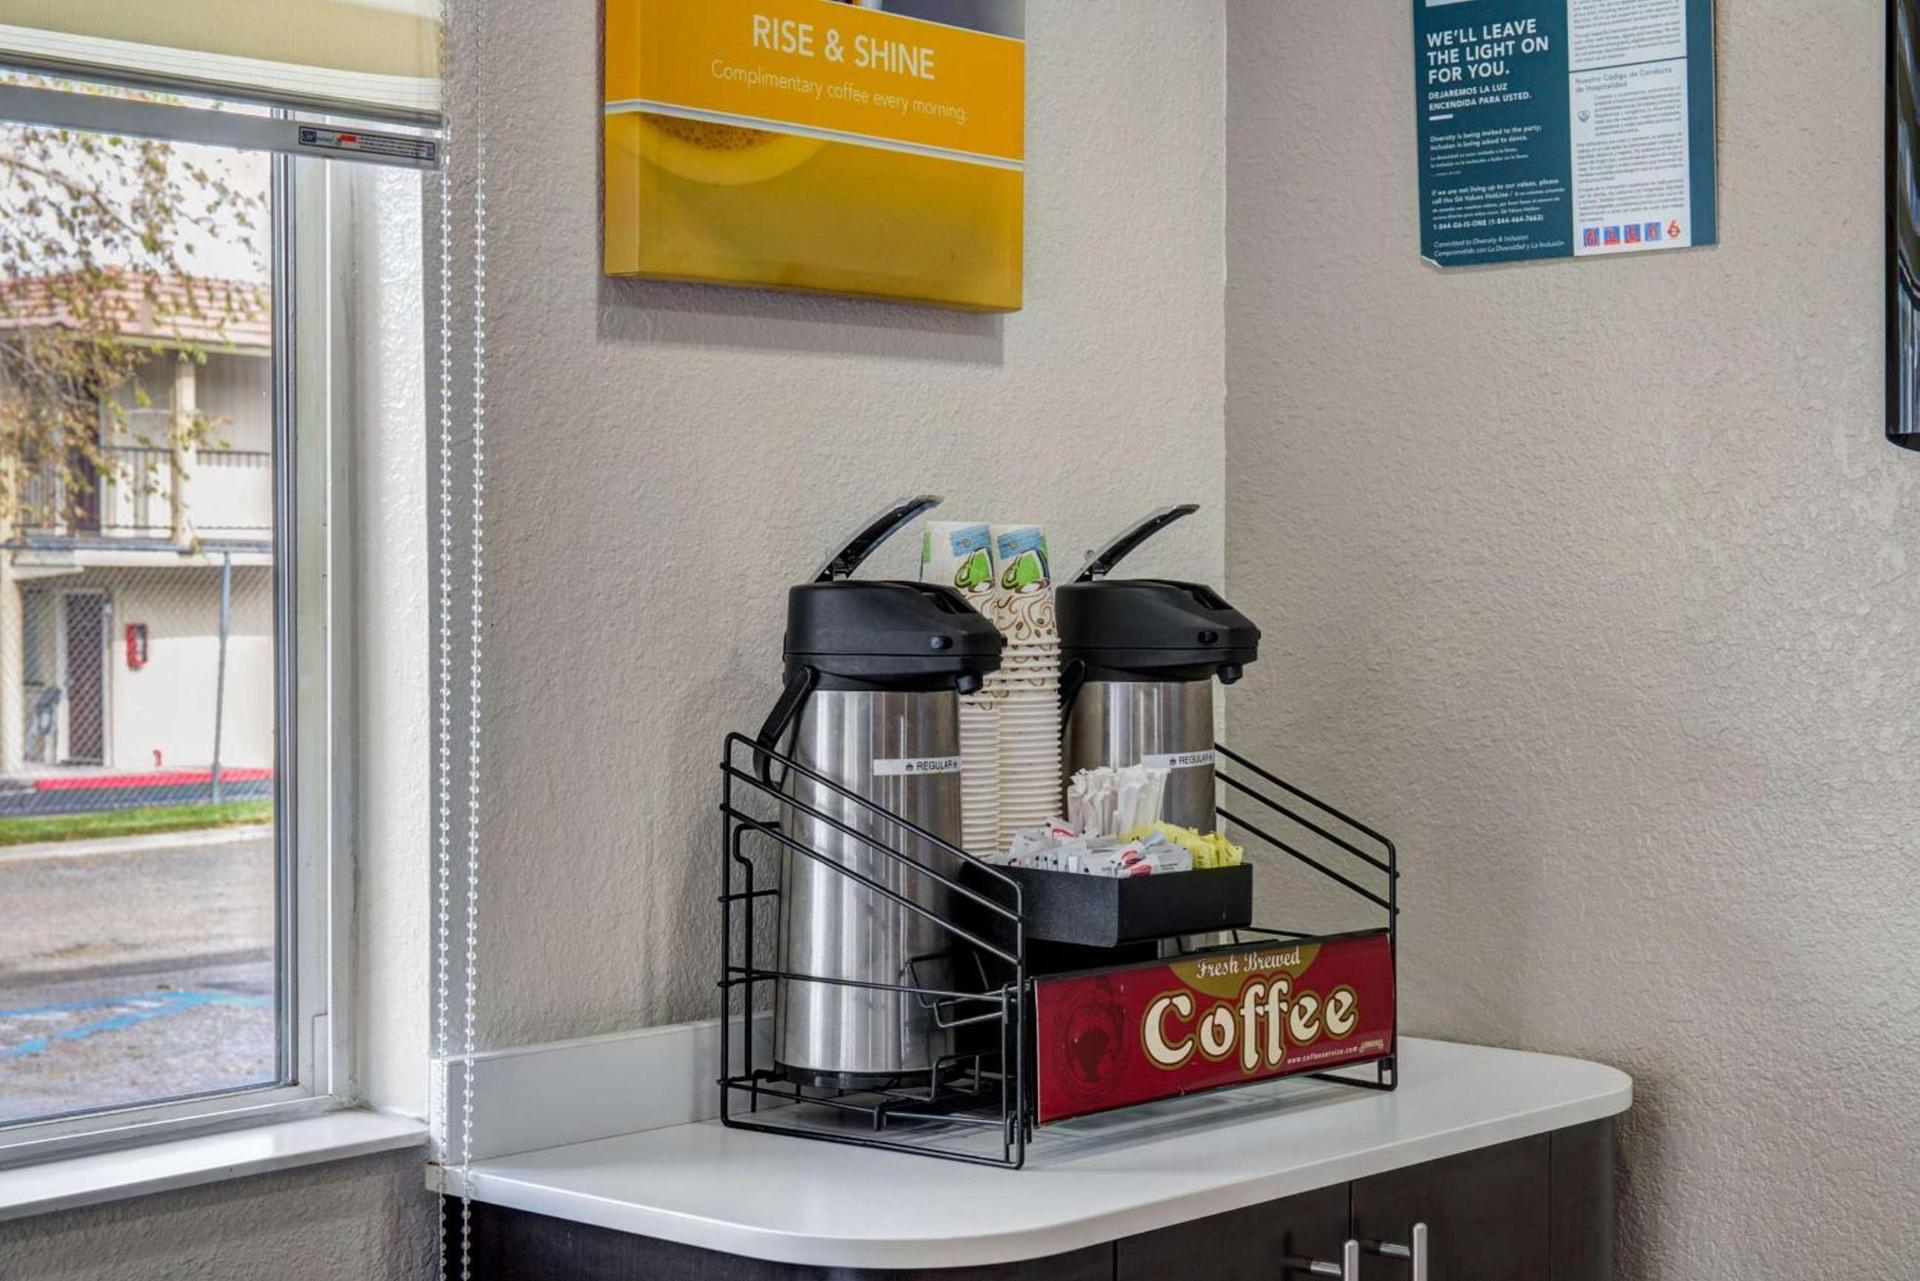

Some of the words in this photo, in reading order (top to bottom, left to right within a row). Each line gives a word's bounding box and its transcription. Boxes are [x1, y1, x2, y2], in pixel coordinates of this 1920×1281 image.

[1427, 28, 1477, 48] WE'LL
[1483, 18, 1537, 40] LEAVE
[752, 14, 814, 57] RISE
[824, 28, 845, 63] &
[854, 35, 936, 80] SHINE
[1427, 48, 1460, 66] THE
[1466, 41, 1515, 61] LIGHT
[1521, 36, 1549, 53] ON
[1428, 67, 1462, 84] FOR
[1467, 61, 1510, 79] YOU.
[711, 59, 824, 97] Complimentary
[828, 80, 868, 104] coffee
[873, 92, 909, 115] every
[1428, 87, 1478, 100] DEJAREMOS
[1480, 86, 1490, 94] LA
[1492, 83, 1508, 92] LUZ
[1429, 99, 1477, 111] ENCENDIDA
[1478, 95, 1501, 105] PARA
[1502, 92, 1532, 102] USTED.
[1463, 131, 1480, 139] being
[1539, 179, 1559, 187] please
[916, 759, 952, 771] REGULAR
[1195, 957, 1239, 979] Fresh
[1244, 946, 1301, 974] Brewed
[1142, 975, 1358, 1074] Coffee
